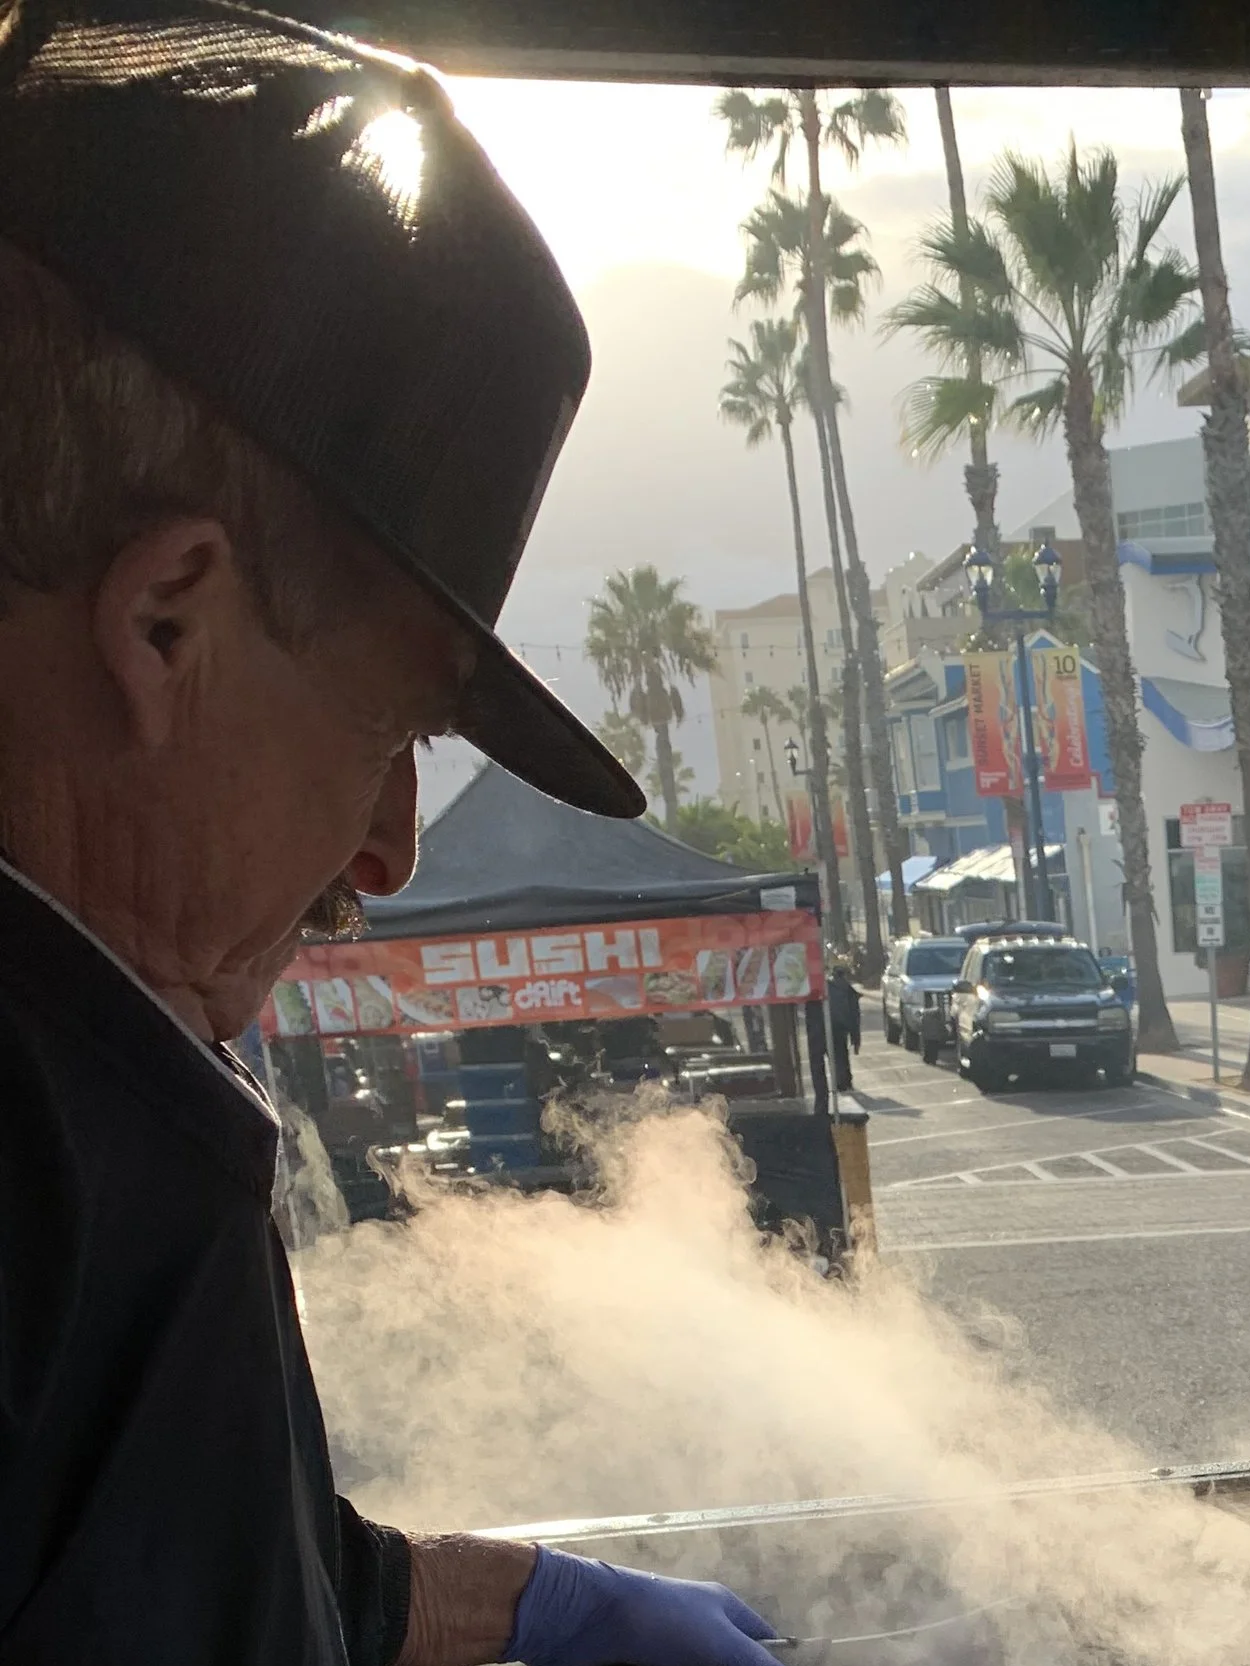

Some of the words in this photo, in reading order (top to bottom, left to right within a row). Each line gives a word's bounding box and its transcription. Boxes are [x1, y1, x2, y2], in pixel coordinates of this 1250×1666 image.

[969, 663, 984, 713] MARKET
[1054, 655, 1077, 675] 10
[420, 928, 663, 984] SUSHI
